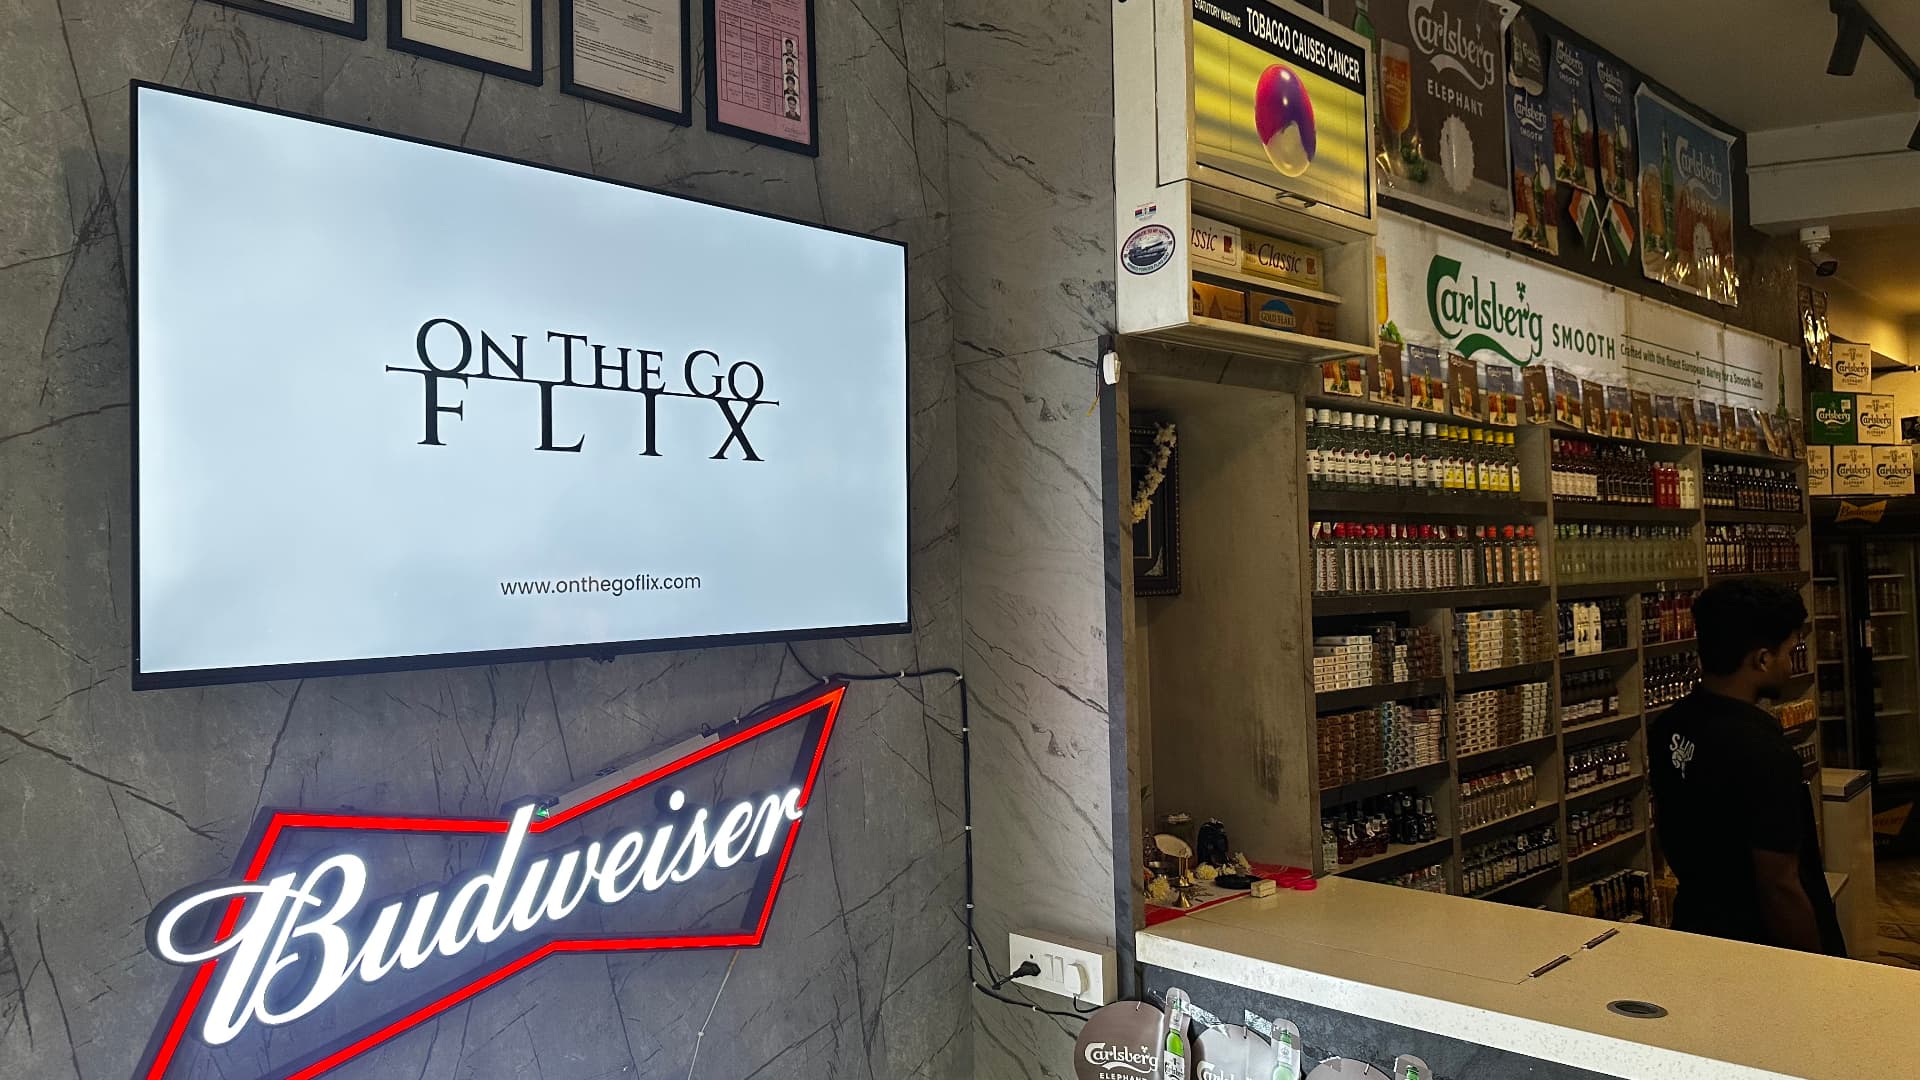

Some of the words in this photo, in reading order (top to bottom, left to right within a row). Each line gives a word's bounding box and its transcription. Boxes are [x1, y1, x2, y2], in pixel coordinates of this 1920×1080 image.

[1194, 0, 1220, 19] STATUTORY
[1220, 10, 1242, 28] WARNING
[1247, 7, 1291, 51] TOBACCO
[1293, 29, 1326, 68] CAUSES
[1327, 46, 1361, 83] CANCER
[1408, 0, 1495, 90] Carlsberg
[1427, 79, 1484, 118] ELEPHANT
[1513, 94, 1548, 131] Carlsberg
[1675, 135, 1723, 200] Carlsberg
[1258, 243, 1302, 275] Classic
[1427, 254, 1543, 366] Carlsberg
[1552, 322, 1616, 361] SMOOTH
[416, 318, 528, 380] ON
[547, 330, 667, 392] THE
[684, 349, 765, 402] GO
[1620, 343, 1642, 360] Crafted
[1643, 350, 1656, 363] with
[1656, 354, 1666, 366] the
[1666, 355, 1682, 369] finest
[1682, 359, 1706, 376] European
[1706, 366, 1722, 382] Barley
[1729, 374, 1734, 383] a
[1733, 373, 1752, 387] Smooth
[1835, 360, 1869, 378] Carlsberg
[1816, 407, 1851, 426] Carlsberg
[1860, 412, 1892, 429] Carlsberg
[1837, 463, 1871, 479] Carlsberg
[1876, 463, 1912, 479] Carlsberg
[501, 574, 702, 597] www.onthegoflix.com
[156, 787, 804, 1047] Budweiser
[1085, 1042, 1159, 1073] Carlsberg
